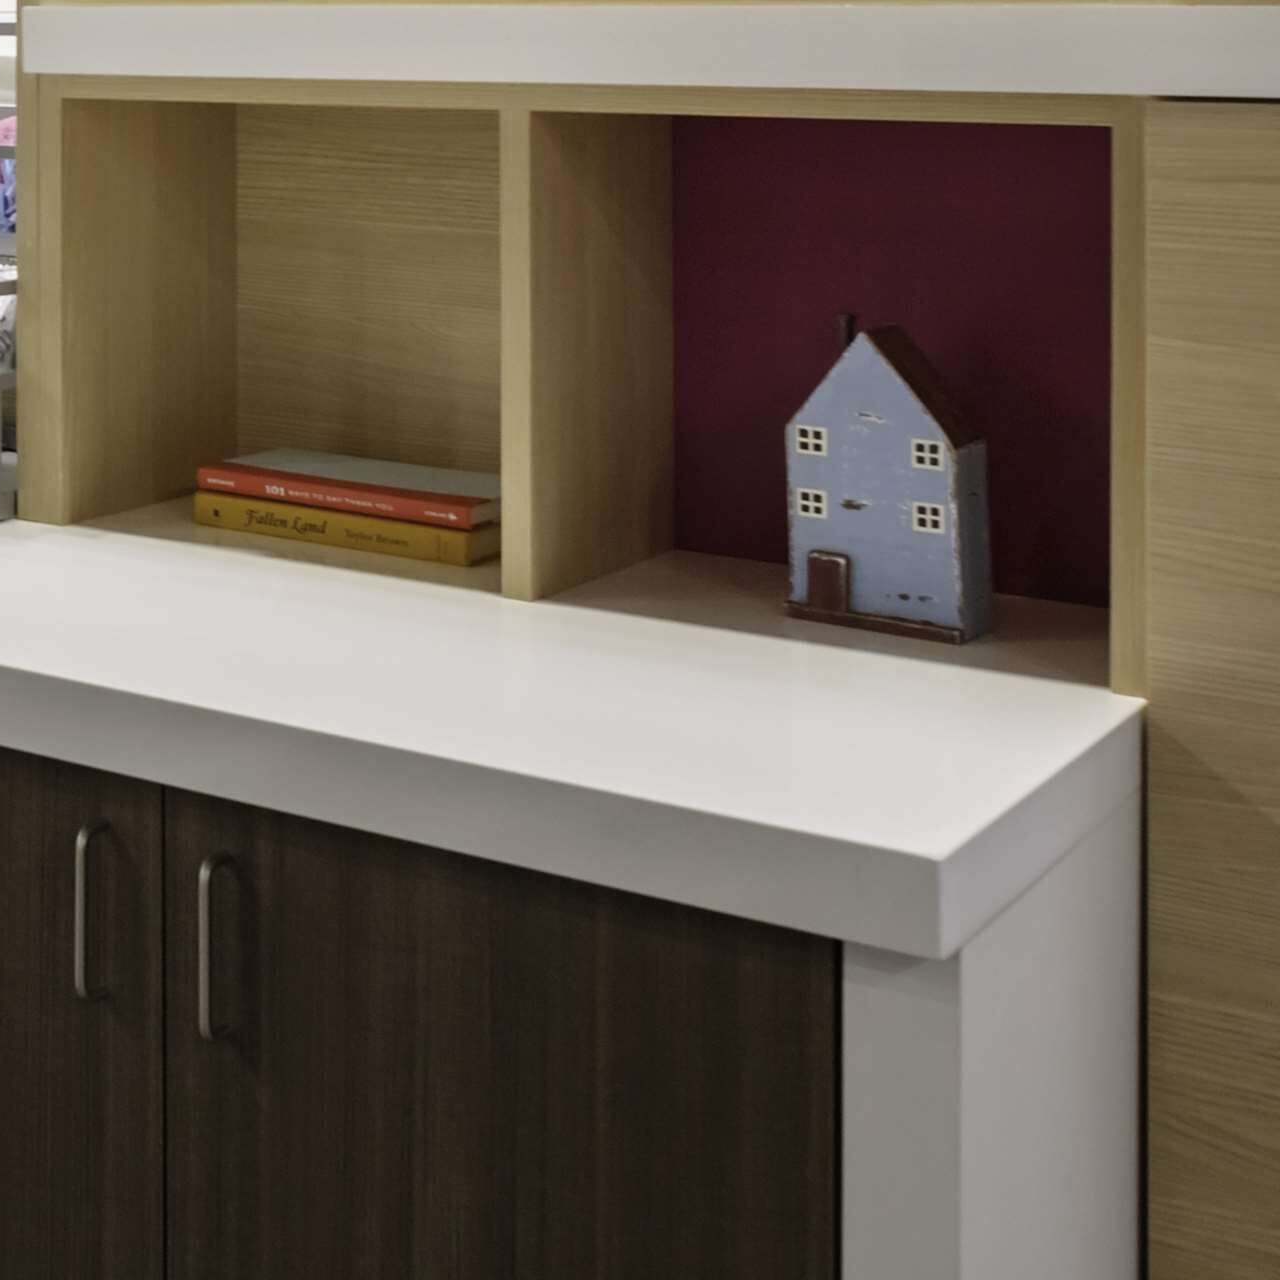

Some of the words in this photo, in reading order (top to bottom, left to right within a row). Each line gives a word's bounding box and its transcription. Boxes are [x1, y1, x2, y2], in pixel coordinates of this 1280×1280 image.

[265, 484, 285, 497] 101
[243, 508, 288, 528] Fallen
[292, 515, 328, 534] Land
